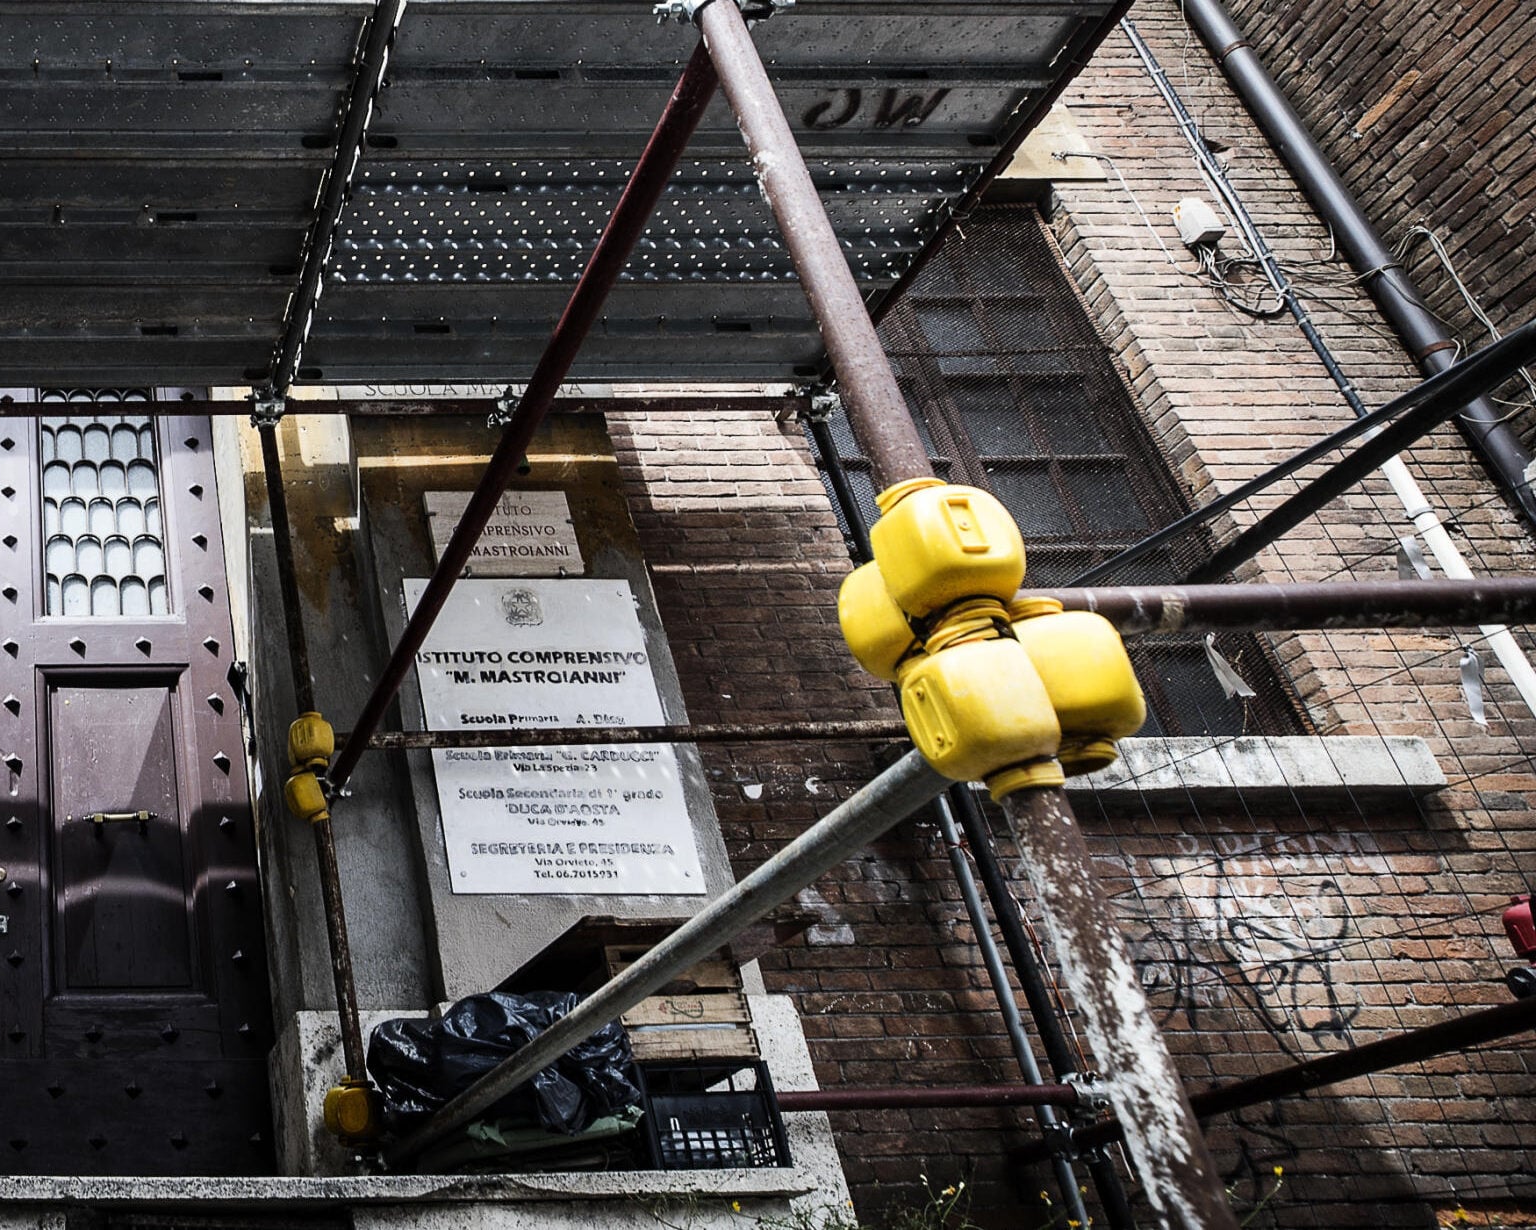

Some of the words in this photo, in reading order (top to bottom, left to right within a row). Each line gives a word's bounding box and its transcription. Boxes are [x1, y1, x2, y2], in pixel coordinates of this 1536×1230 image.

[417, 651, 502, 664] ISTITUTO
[507, 651, 648, 666] COMPRENSIVO
[460, 713, 506, 725] Scuola
[459, 787, 505, 799] Scuola
[470, 842, 564, 855] SEGRETERIA
[534, 857, 553, 866] Via
[533, 870, 554, 879] Tel.
